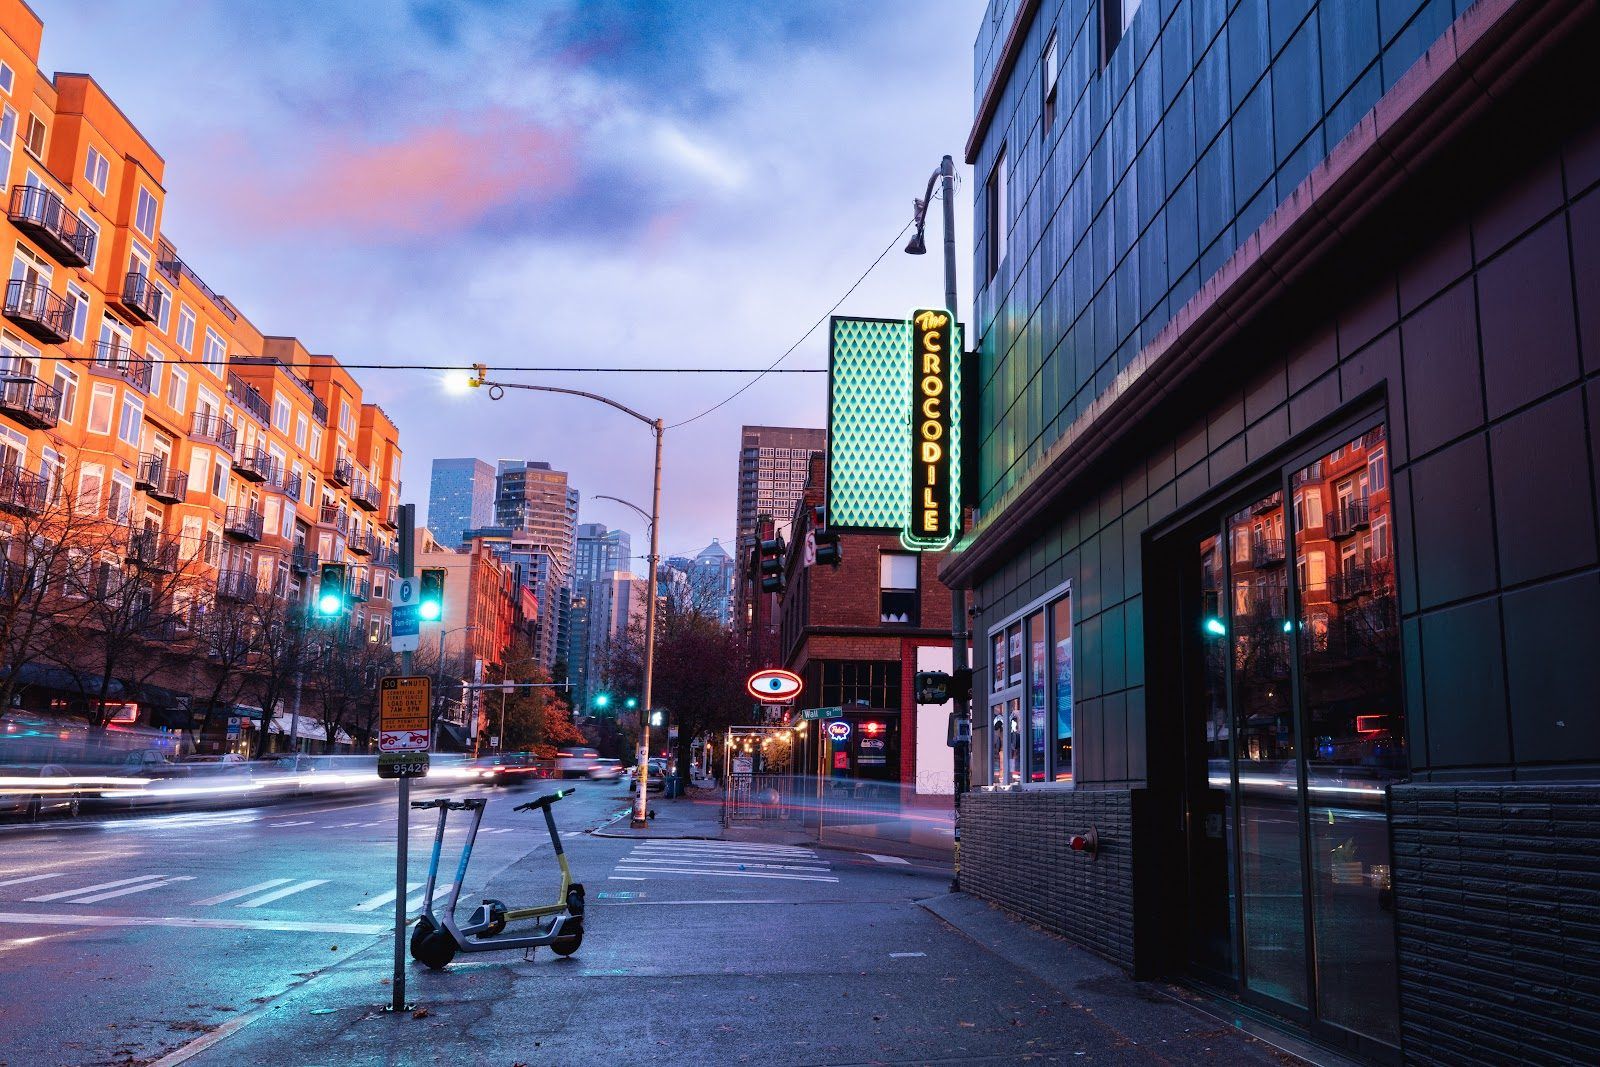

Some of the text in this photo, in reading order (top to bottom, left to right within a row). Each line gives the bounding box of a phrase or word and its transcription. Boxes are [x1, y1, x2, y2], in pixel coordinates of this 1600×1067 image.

[915, 310, 948, 331] The
[921, 331, 944, 532] CROCODILE
[384, 679, 427, 688] 30 MINUTE
[804, 709, 819, 719] Wall
[393, 763, 430, 774] 95426
